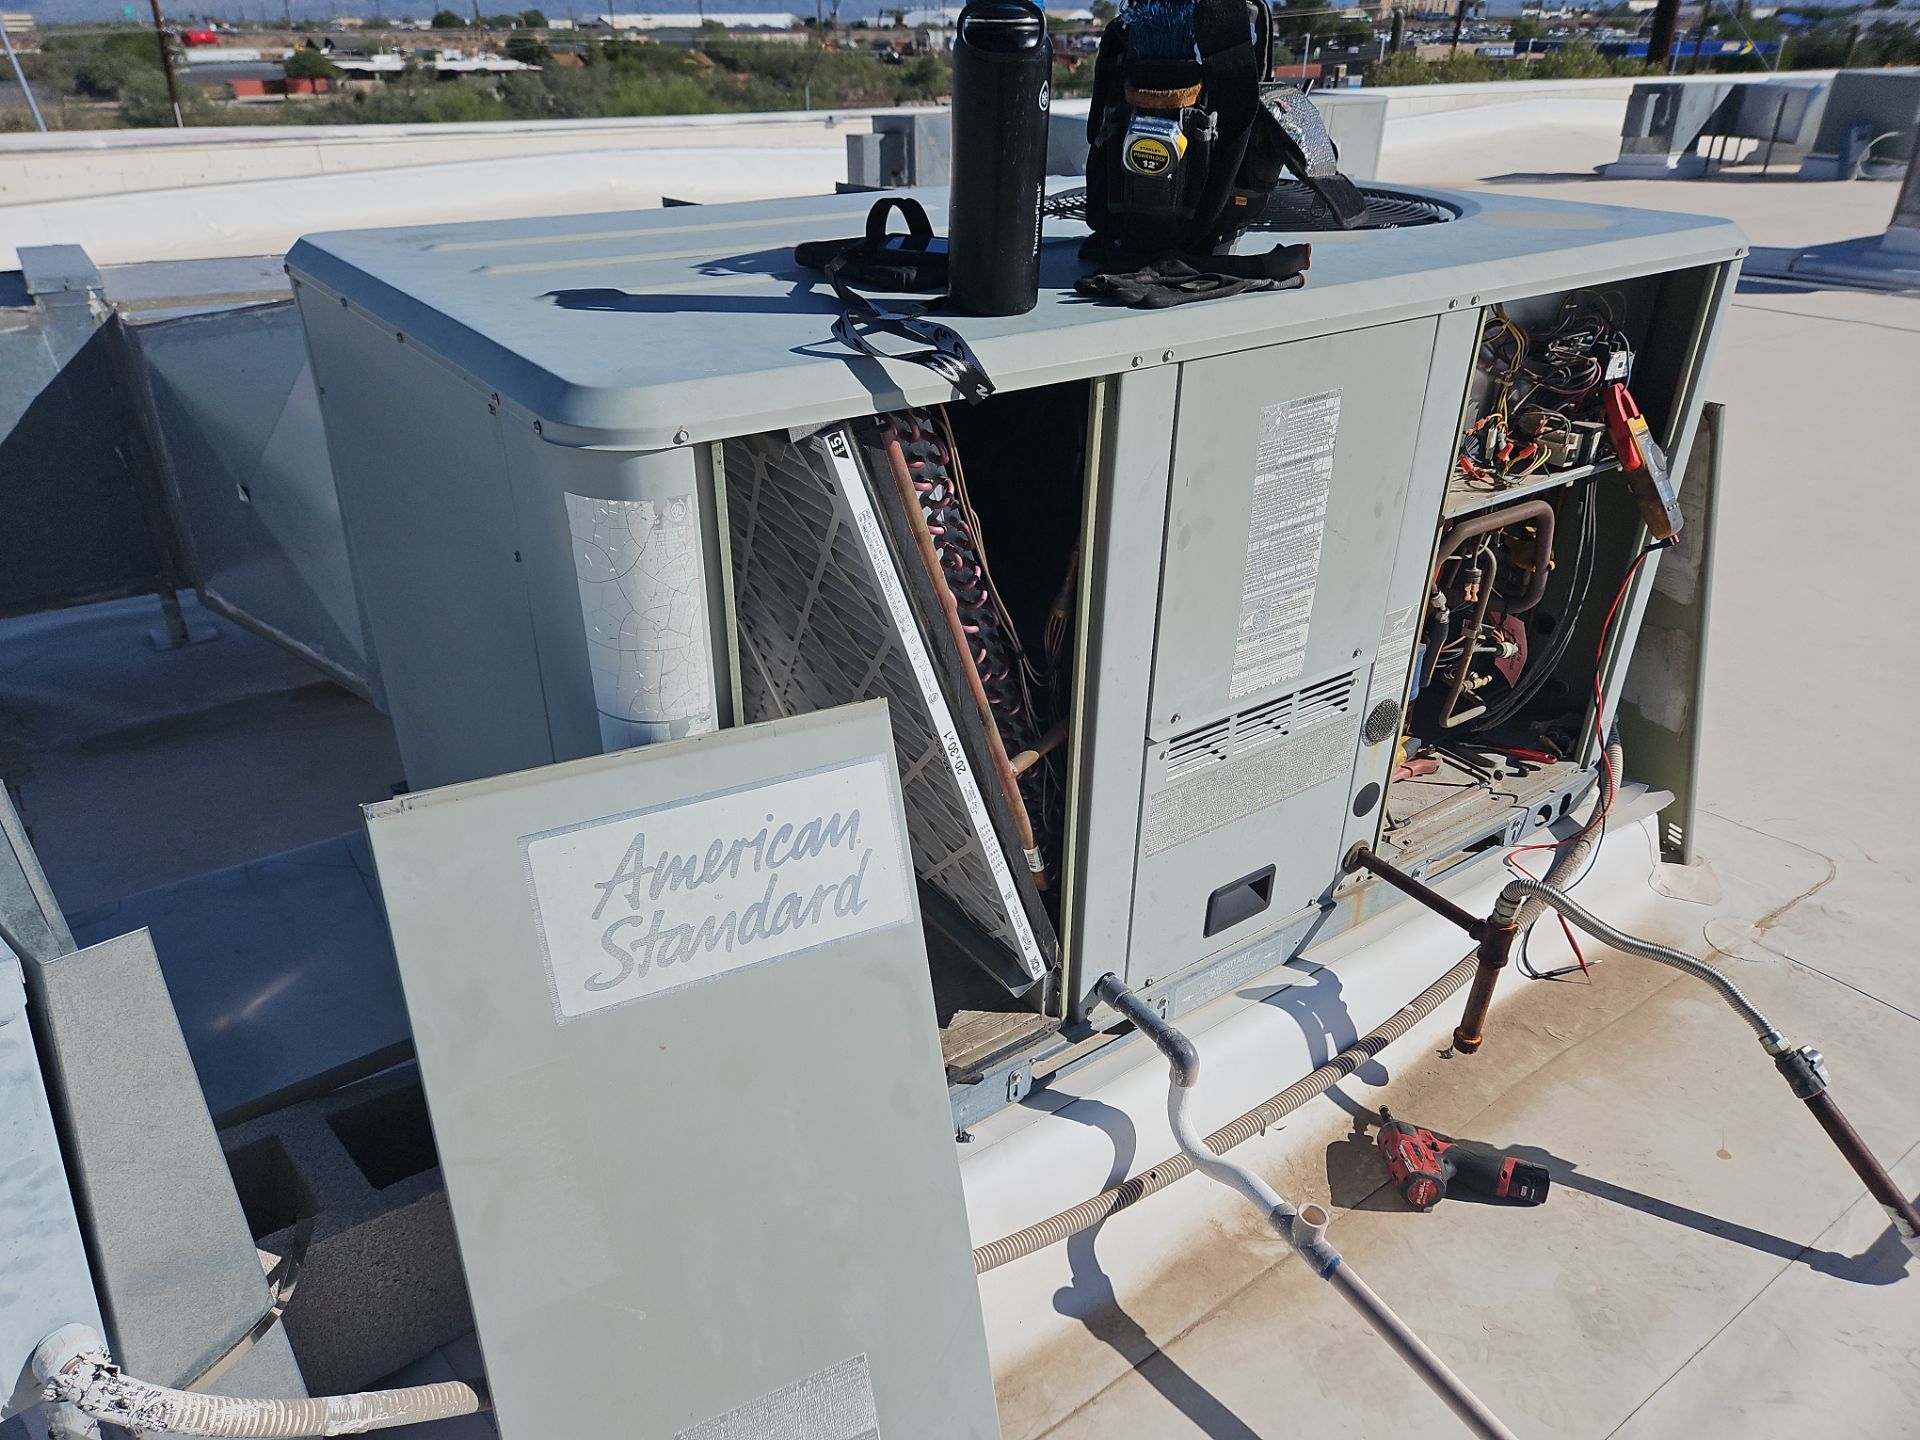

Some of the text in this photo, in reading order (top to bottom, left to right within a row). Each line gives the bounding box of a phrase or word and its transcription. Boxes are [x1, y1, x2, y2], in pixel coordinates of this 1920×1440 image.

[1133, 152, 1167, 162] POWERLOCK
[1032, 183, 1042, 257] ThermoFlask
[830, 437, 842, 448] 5
[591, 808, 861, 921] American
[583, 847, 874, 992] Standard
[1416, 1181, 1426, 1205] FUEL
